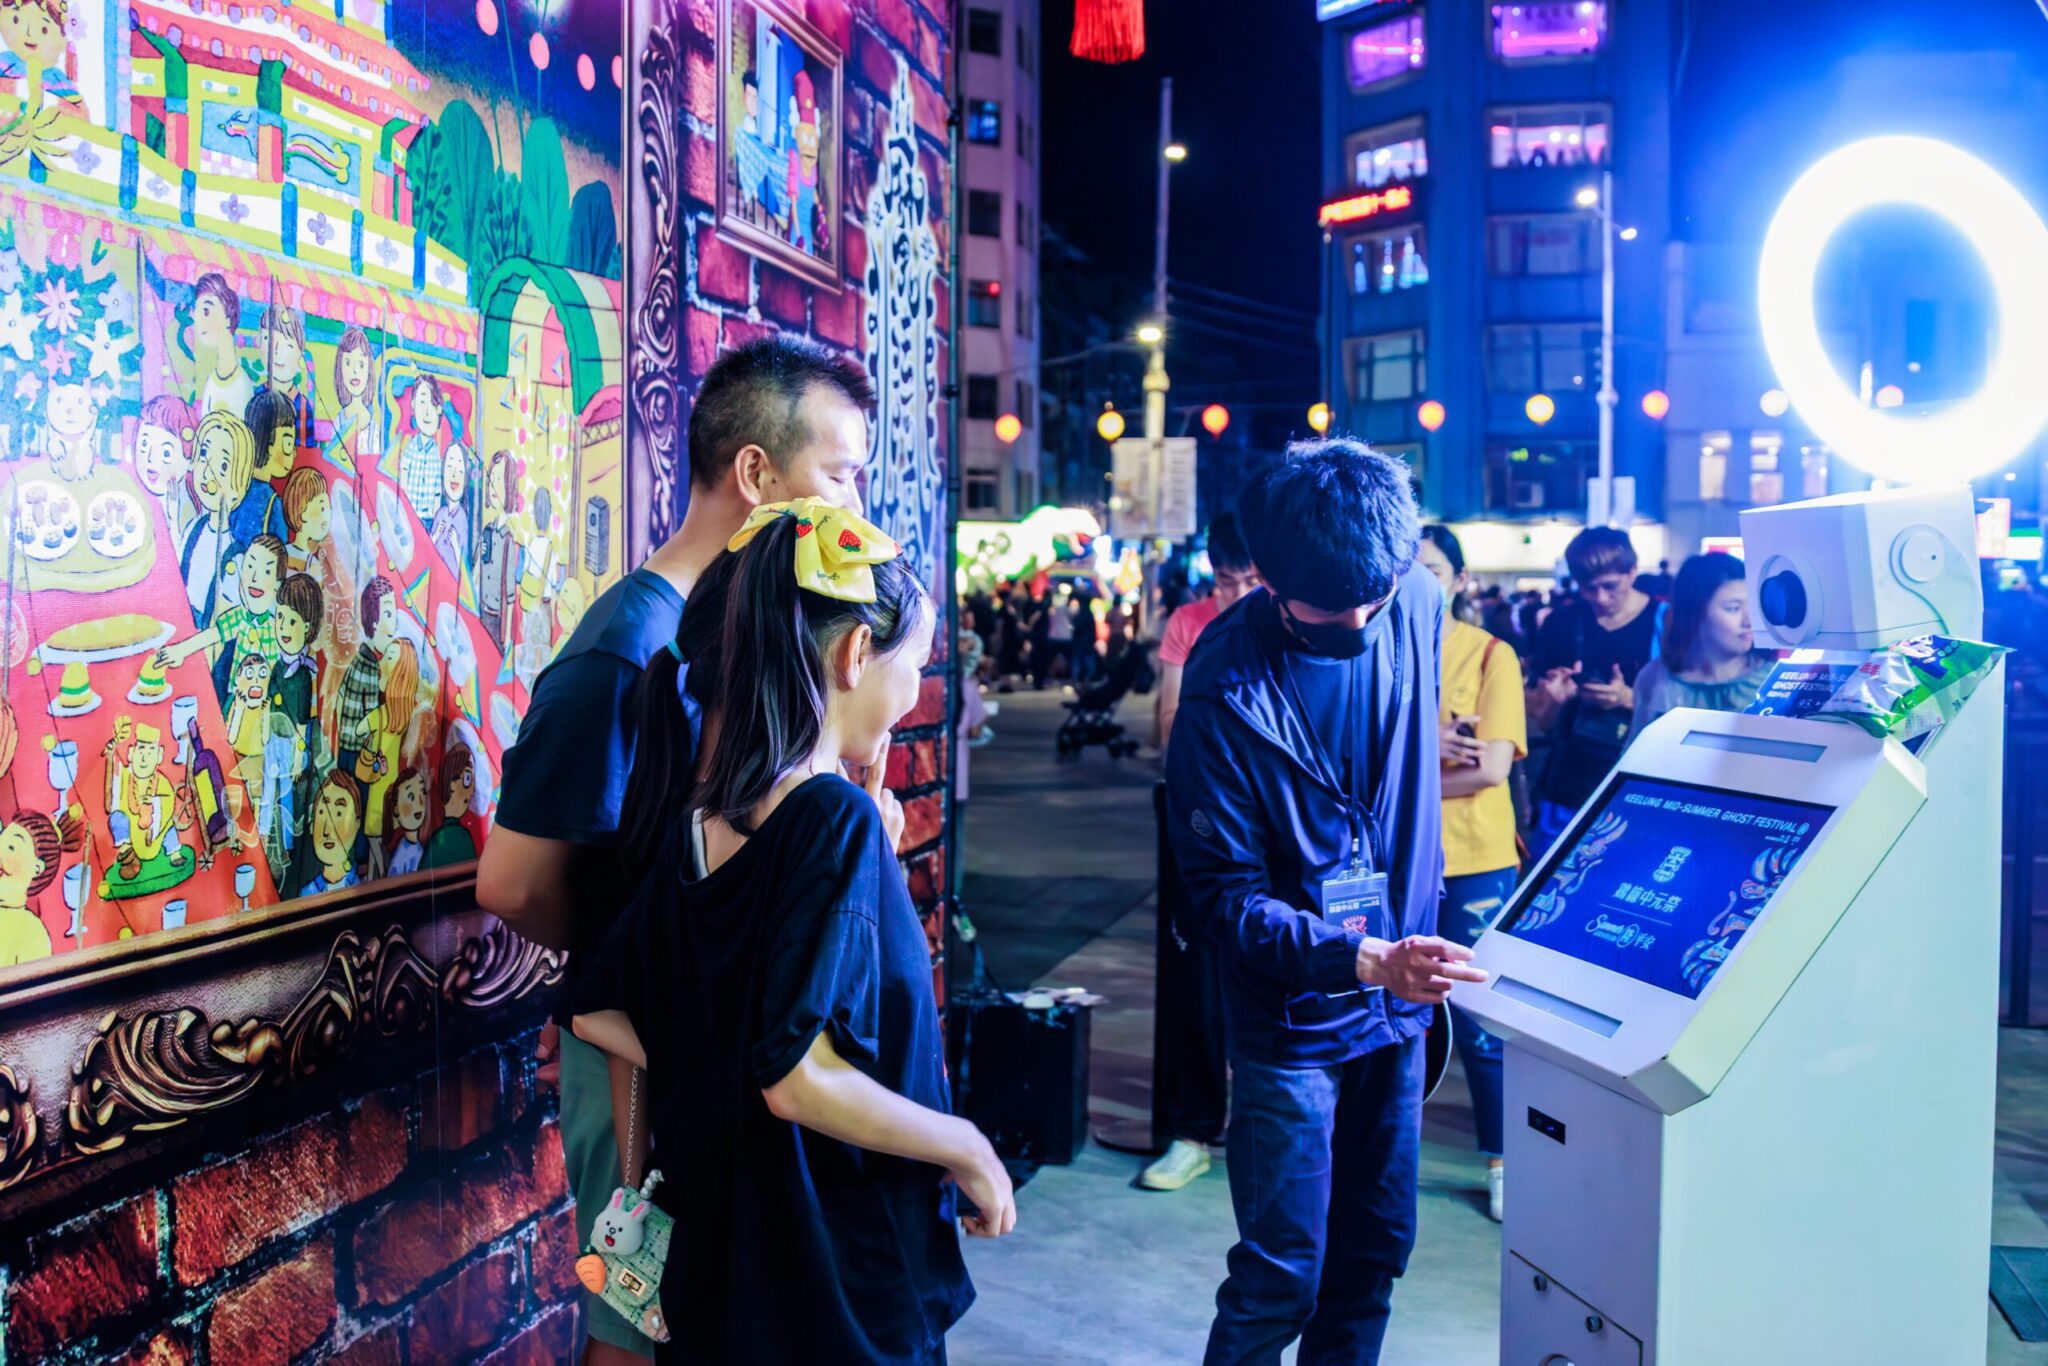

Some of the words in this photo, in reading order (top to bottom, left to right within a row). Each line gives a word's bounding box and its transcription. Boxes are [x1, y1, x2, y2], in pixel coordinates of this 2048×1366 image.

[1772, 682, 1801, 690] GHOST
[1625, 794, 1661, 808] KEELUNG
[1663, 800, 1720, 818] MID-SUMMER
[1721, 811, 1755, 824] GHOST
[1755, 817, 1797, 833] FESTIVAL
